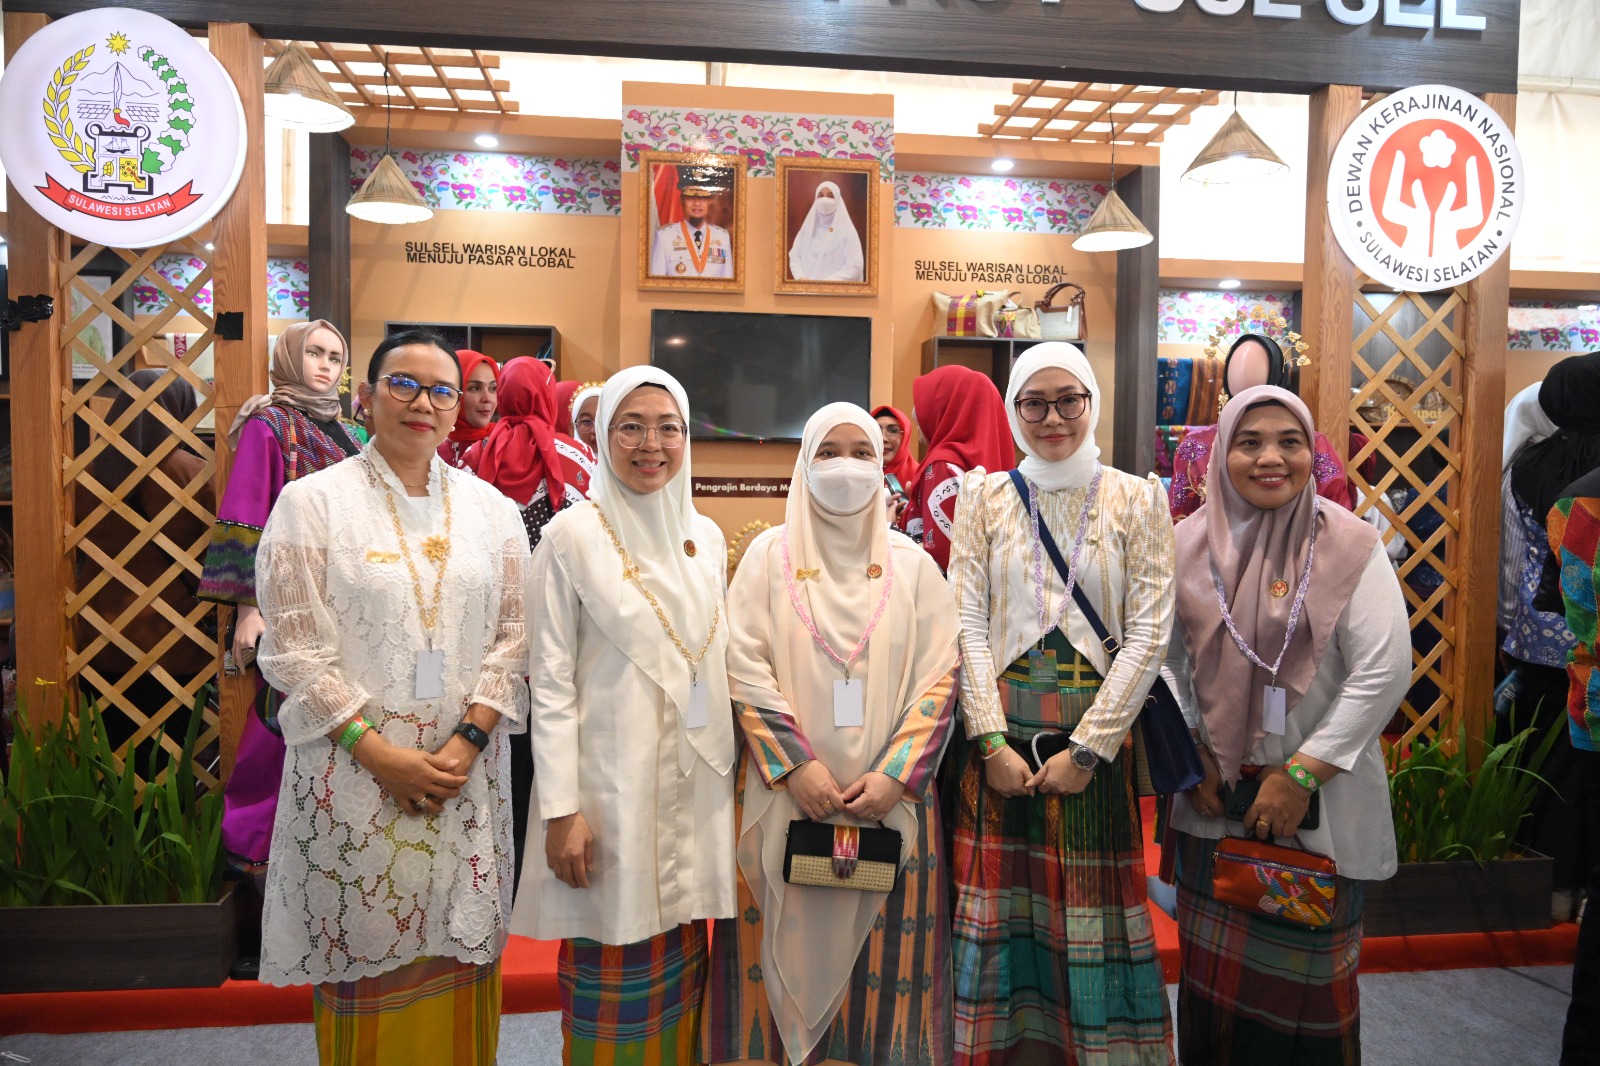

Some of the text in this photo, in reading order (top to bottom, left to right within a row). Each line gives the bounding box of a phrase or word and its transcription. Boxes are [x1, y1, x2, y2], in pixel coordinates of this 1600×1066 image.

[1347, 94, 1515, 221] DEWAN KERAJINAN NASIONAL
[68, 194, 122, 216] SULAWESI
[125, 198, 171, 216] SELATAN
[405, 241, 576, 259] SULSEL WARISAN LOKAL
[1359, 231, 1498, 283] SULAWESI SELATAN
[406, 252, 575, 269] MENUJU PASAR GLOBAL
[914, 260, 1068, 276] SULSEL WARISAN LOKAL
[915, 270, 967, 282] MENUJU
[971, 272, 1013, 284] PASAR
[695, 483, 790, 493] Pengrajin Berdaya M
